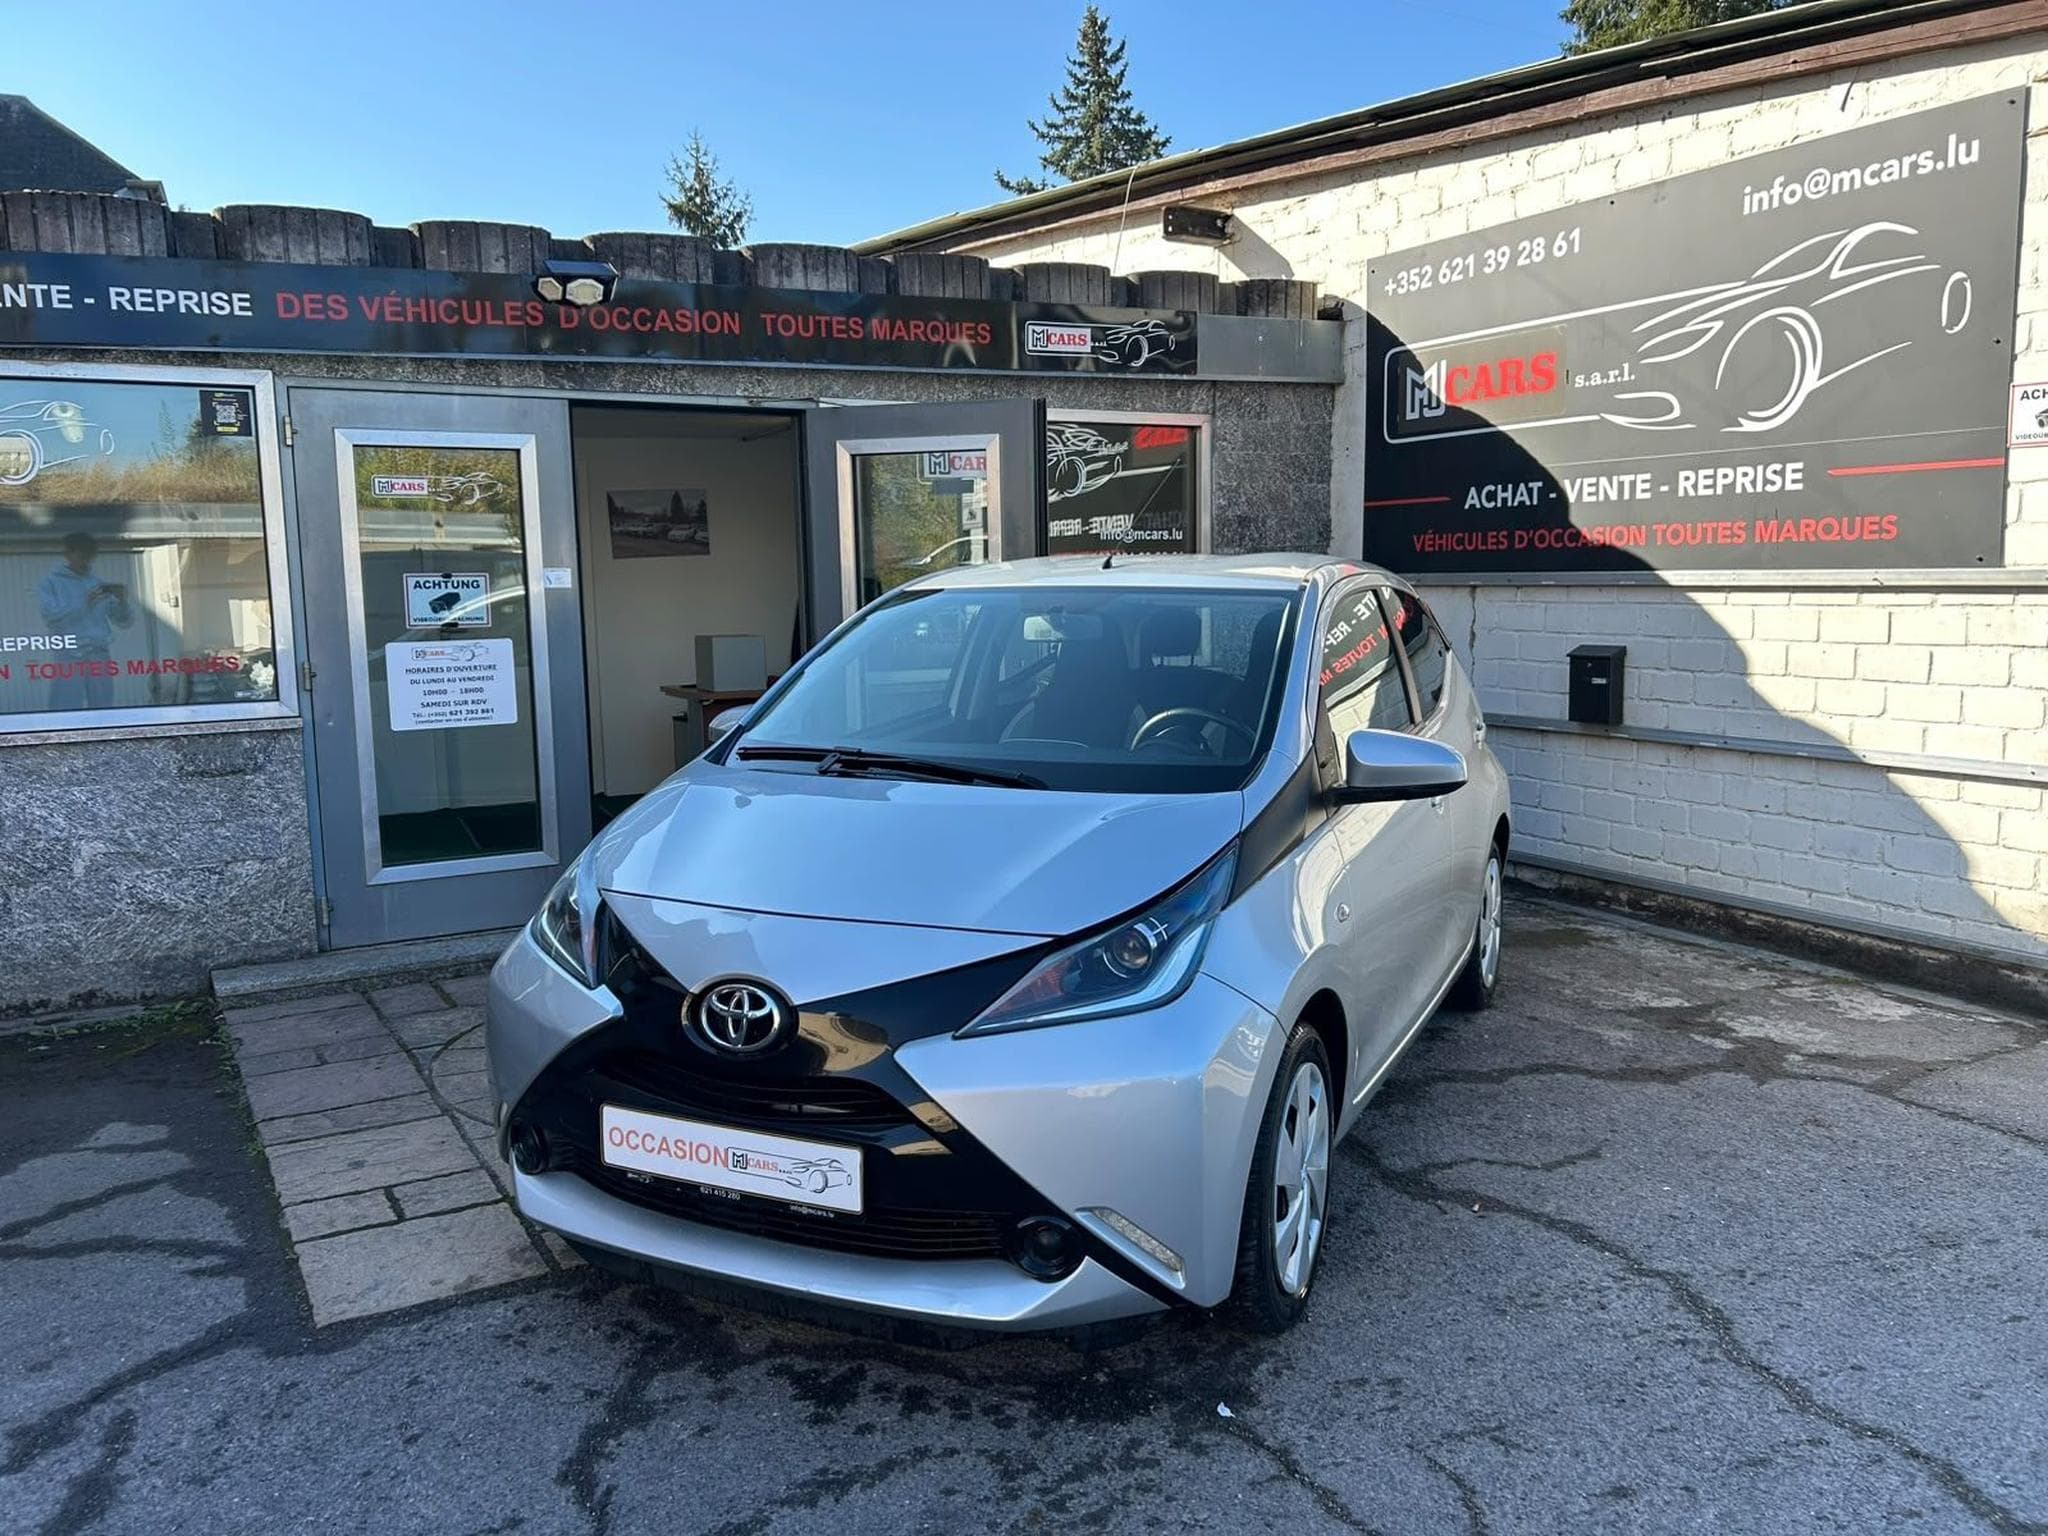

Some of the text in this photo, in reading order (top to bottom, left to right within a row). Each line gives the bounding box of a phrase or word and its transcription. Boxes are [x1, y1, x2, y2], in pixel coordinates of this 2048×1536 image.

[1743, 133, 1981, 216] info@mcars.lu
[1384, 226, 1582, 297] +352 621 39 28 61
[0, 283, 73, 309] NTE
[108, 286, 253, 317] REPRISE
[275, 292, 349, 320] DES
[358, 289, 545, 327] VÉHICULES
[558, 305, 741, 336] D'OCCASION
[760, 312, 865, 341] TOUTES
[870, 317, 992, 346] MARQUES
[1574, 362, 1636, 388] s.a.r.l.
[1463, 481, 1544, 510] ACHAT
[1563, 474, 1653, 504] VENTE
[1677, 462, 1805, 497] REPRISE
[1412, 515, 1899, 552] VÉHICULES D'OCCASION TOUTES MARQUES
[413, 579, 481, 590] ACHTUNG
[0, 634, 77, 651] EPRISE
[24, 660, 120, 681] TOUTES
[127, 655, 241, 677] MARQUES
[405, 666, 445, 675] HORAIRES
[410, 674, 495, 686] DU LUNDI AU VENDREDI
[420, 698, 488, 709] SAMEDI SUR RDV
[422, 688, 448, 697] 10H00
[459, 686, 485, 696] 18H00
[608, 1126, 729, 1168] OCCASION
